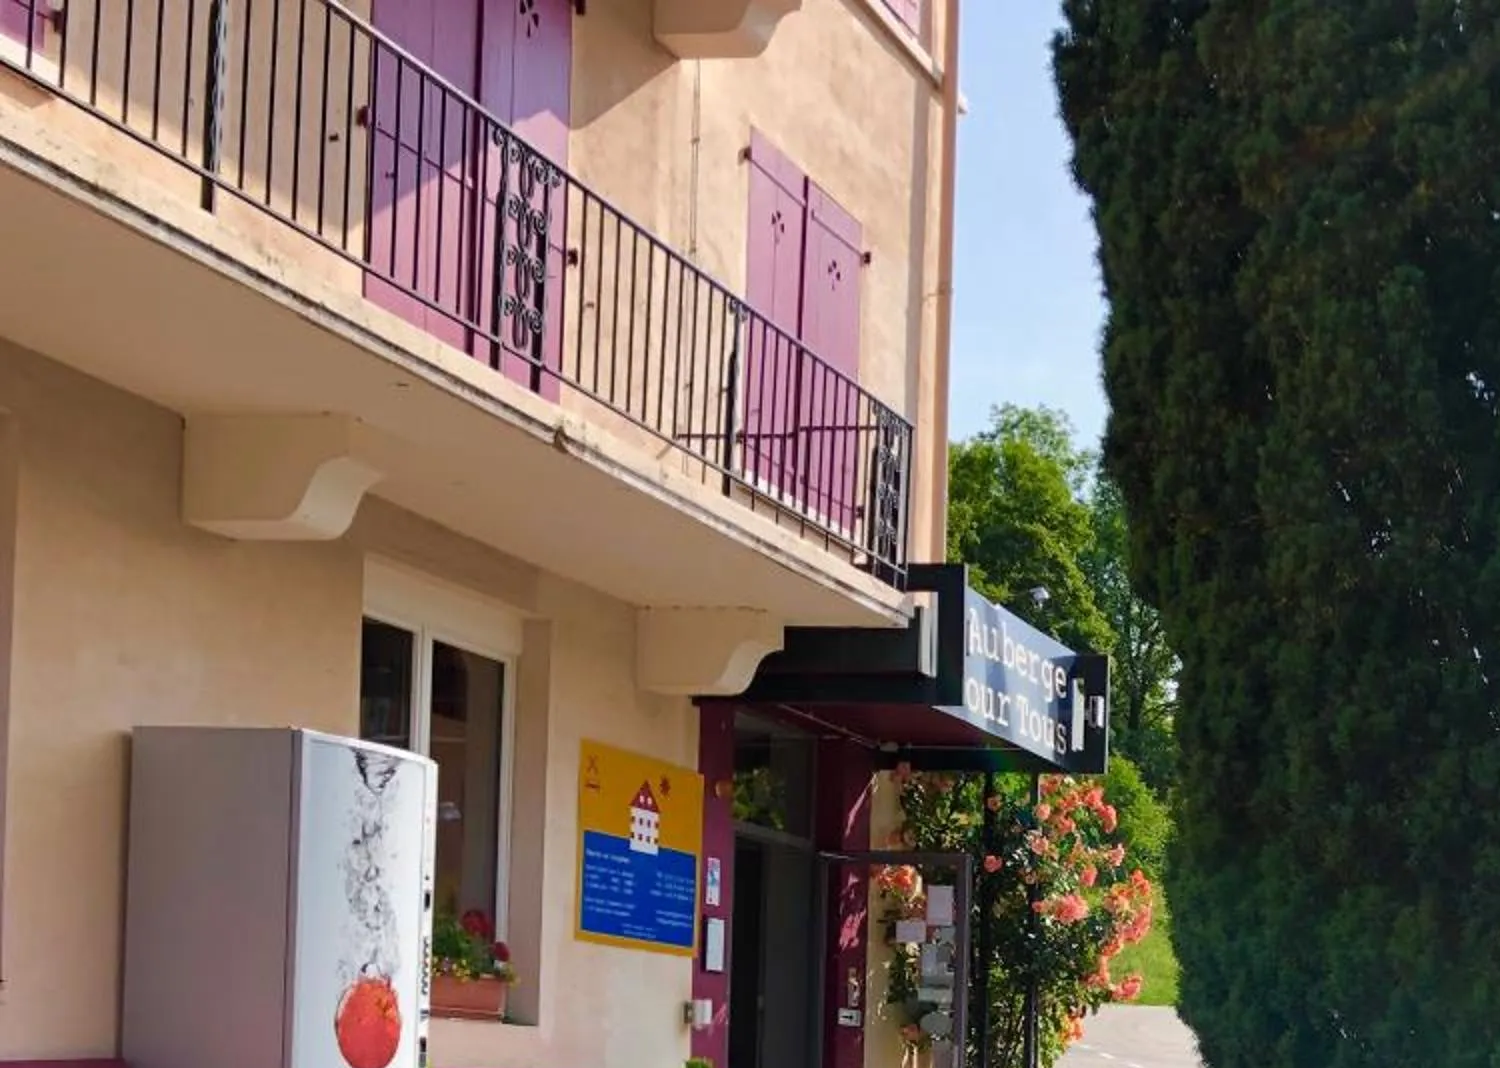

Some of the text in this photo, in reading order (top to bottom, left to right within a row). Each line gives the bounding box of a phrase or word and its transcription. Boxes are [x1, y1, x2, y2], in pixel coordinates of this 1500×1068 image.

[968, 607, 1067, 703] Auberge
[965, 677, 1067, 755] our Tous
